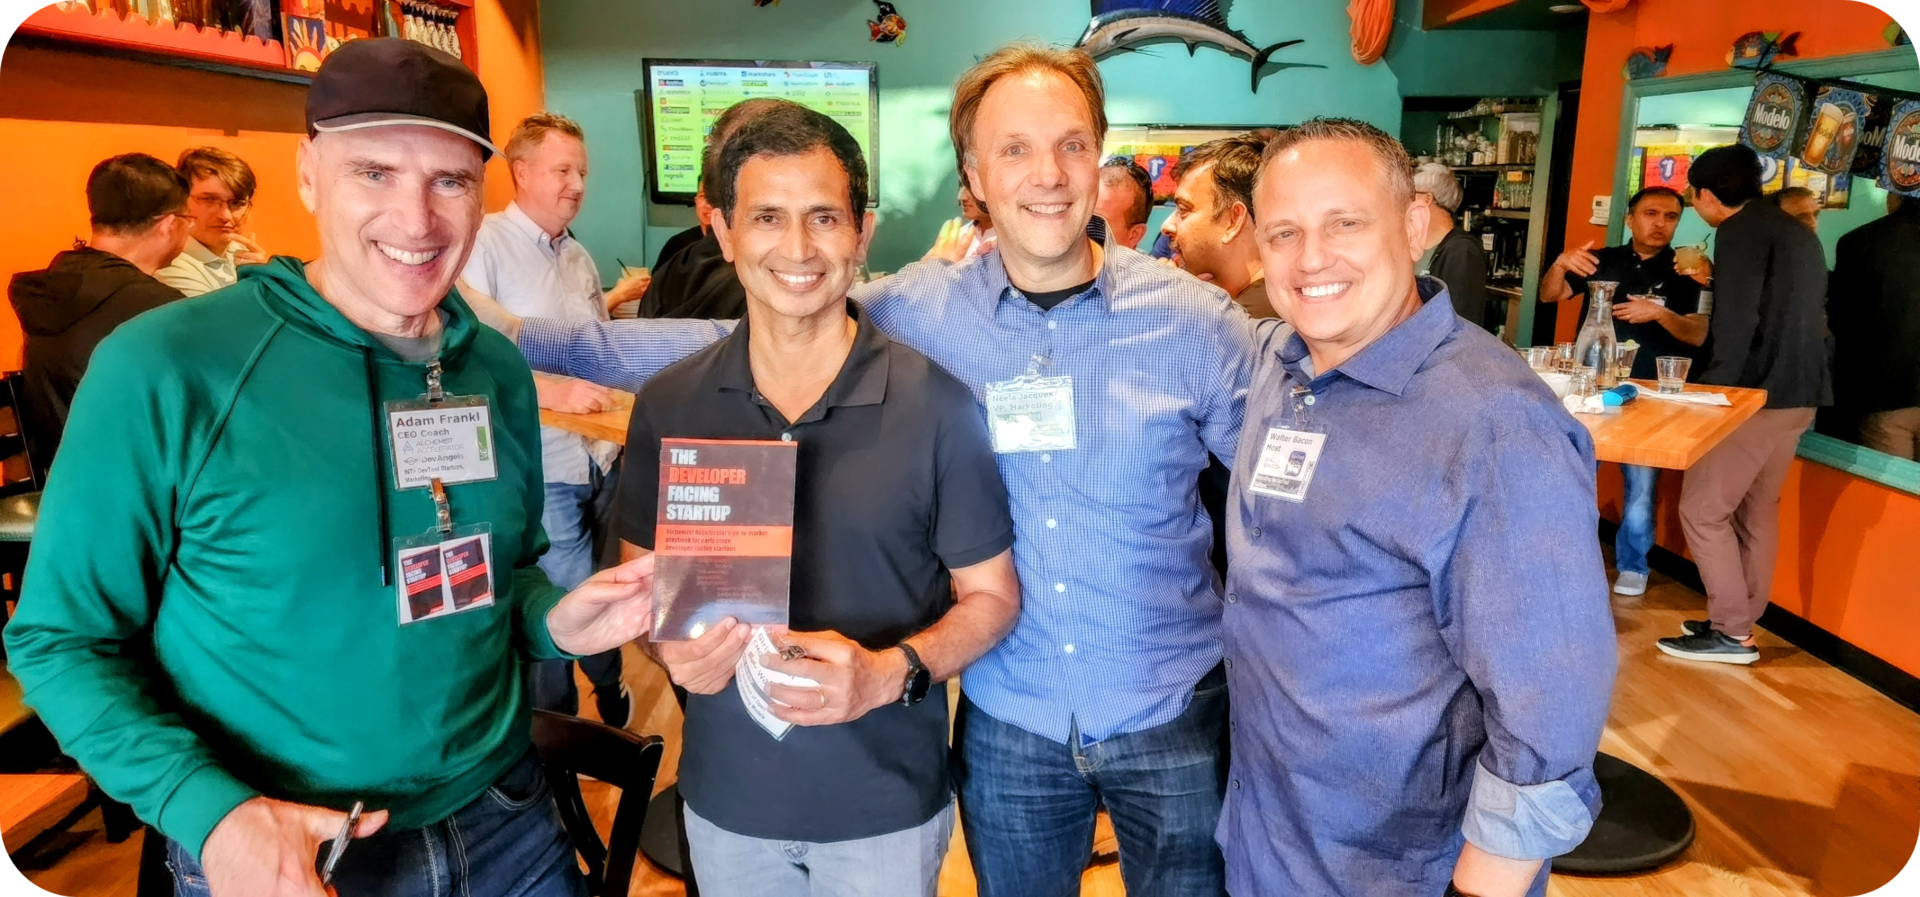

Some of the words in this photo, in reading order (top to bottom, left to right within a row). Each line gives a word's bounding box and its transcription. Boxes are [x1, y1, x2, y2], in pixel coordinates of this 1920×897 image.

[1754, 103, 1790, 130] Modelo
[1010, 402, 1053, 410] Marketing
[396, 416, 434, 427] Adam
[440, 412, 480, 424] Frankl
[398, 430, 417, 439] CEO
[420, 428, 450, 437] Coach
[1270, 433, 1292, 442] Walter
[1293, 436, 1313, 445] Bacon
[416, 438, 454, 446] ALCHEMIST
[1266, 443, 1282, 452] Host
[417, 444, 464, 454] ACCELERATOR
[670, 448, 697, 465] THE
[418, 466, 440, 474] DevTool
[669, 467, 746, 484] DEVELOPER
[668, 485, 720, 502] FACING
[666, 504, 731, 521] STARTUP
[751, 704, 766, 719] Models
[755, 699, 767, 712] Open
